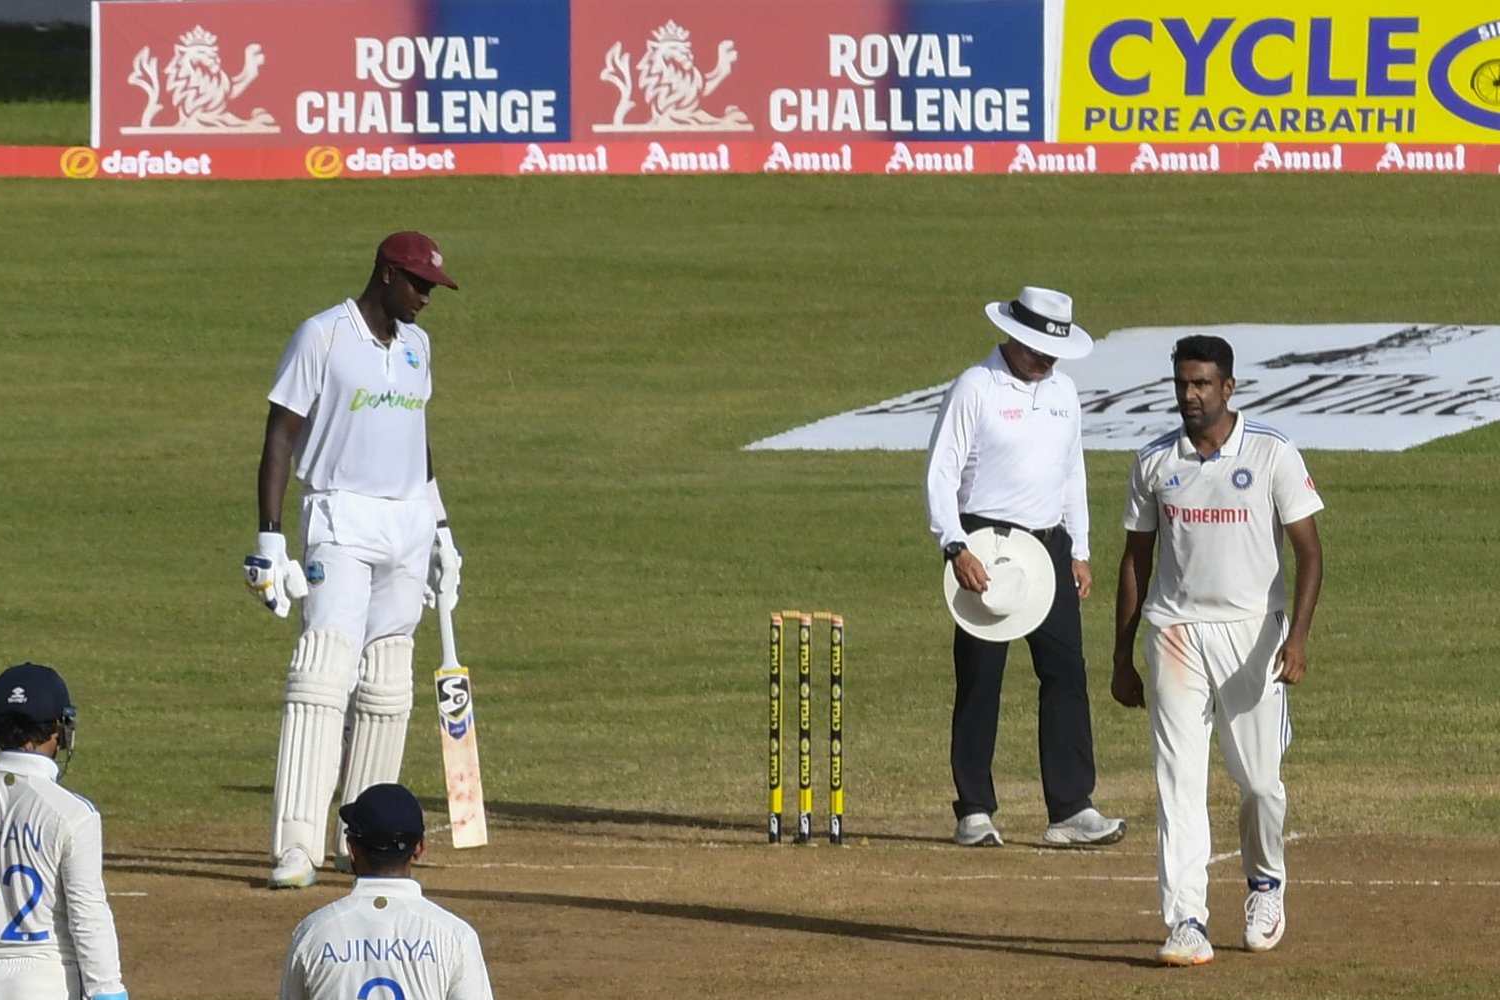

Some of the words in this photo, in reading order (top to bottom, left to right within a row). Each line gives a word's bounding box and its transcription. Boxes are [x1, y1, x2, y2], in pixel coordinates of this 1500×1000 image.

[1088, 16, 1420, 97] CYCLE
[296, 91, 556, 135] CHALLENGE
[769, 88, 1030, 133] CHALLENGE
[1084, 107, 1180, 132] PURE
[1189, 106, 1415, 133] AGARBATHI
[101, 149, 212, 177] dafabet
[345, 146, 456, 174] dafabet
[519, 143, 609, 173] Amul
[641, 142, 731, 173] Amul
[763, 142, 853, 173] Amul
[885, 142, 975, 173] Amul
[1007, 142, 1097, 173] Amul
[1130, 142, 1220, 173] Amul
[1253, 142, 1343, 173] Amul
[1376, 142, 1466, 173] Amul
[320, 938, 436, 965] AJINKYA
